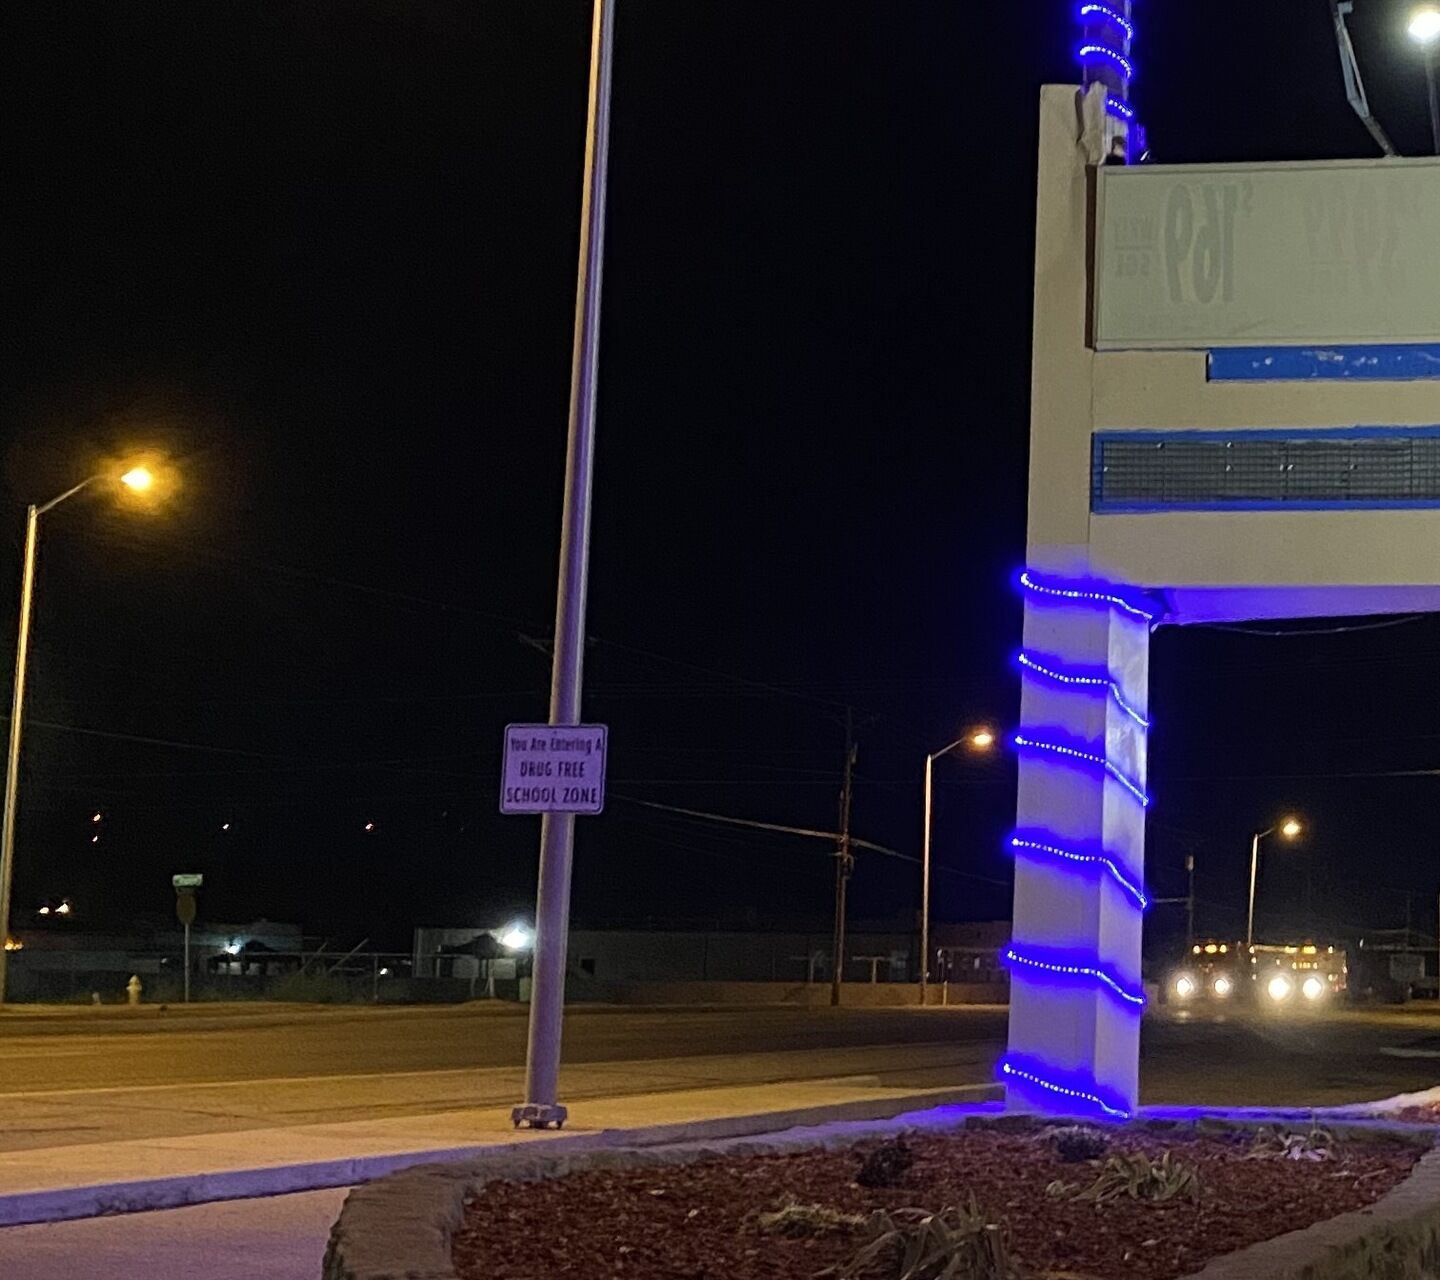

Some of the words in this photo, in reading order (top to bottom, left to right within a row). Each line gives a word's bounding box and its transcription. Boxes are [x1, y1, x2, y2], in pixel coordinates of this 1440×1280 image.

[530, 738, 547, 752] Are
[519, 761, 553, 778] DRUG
[557, 761, 586, 778] FREE
[506, 786, 556, 803] SCHOOL
[563, 786, 598, 804] ZONE
